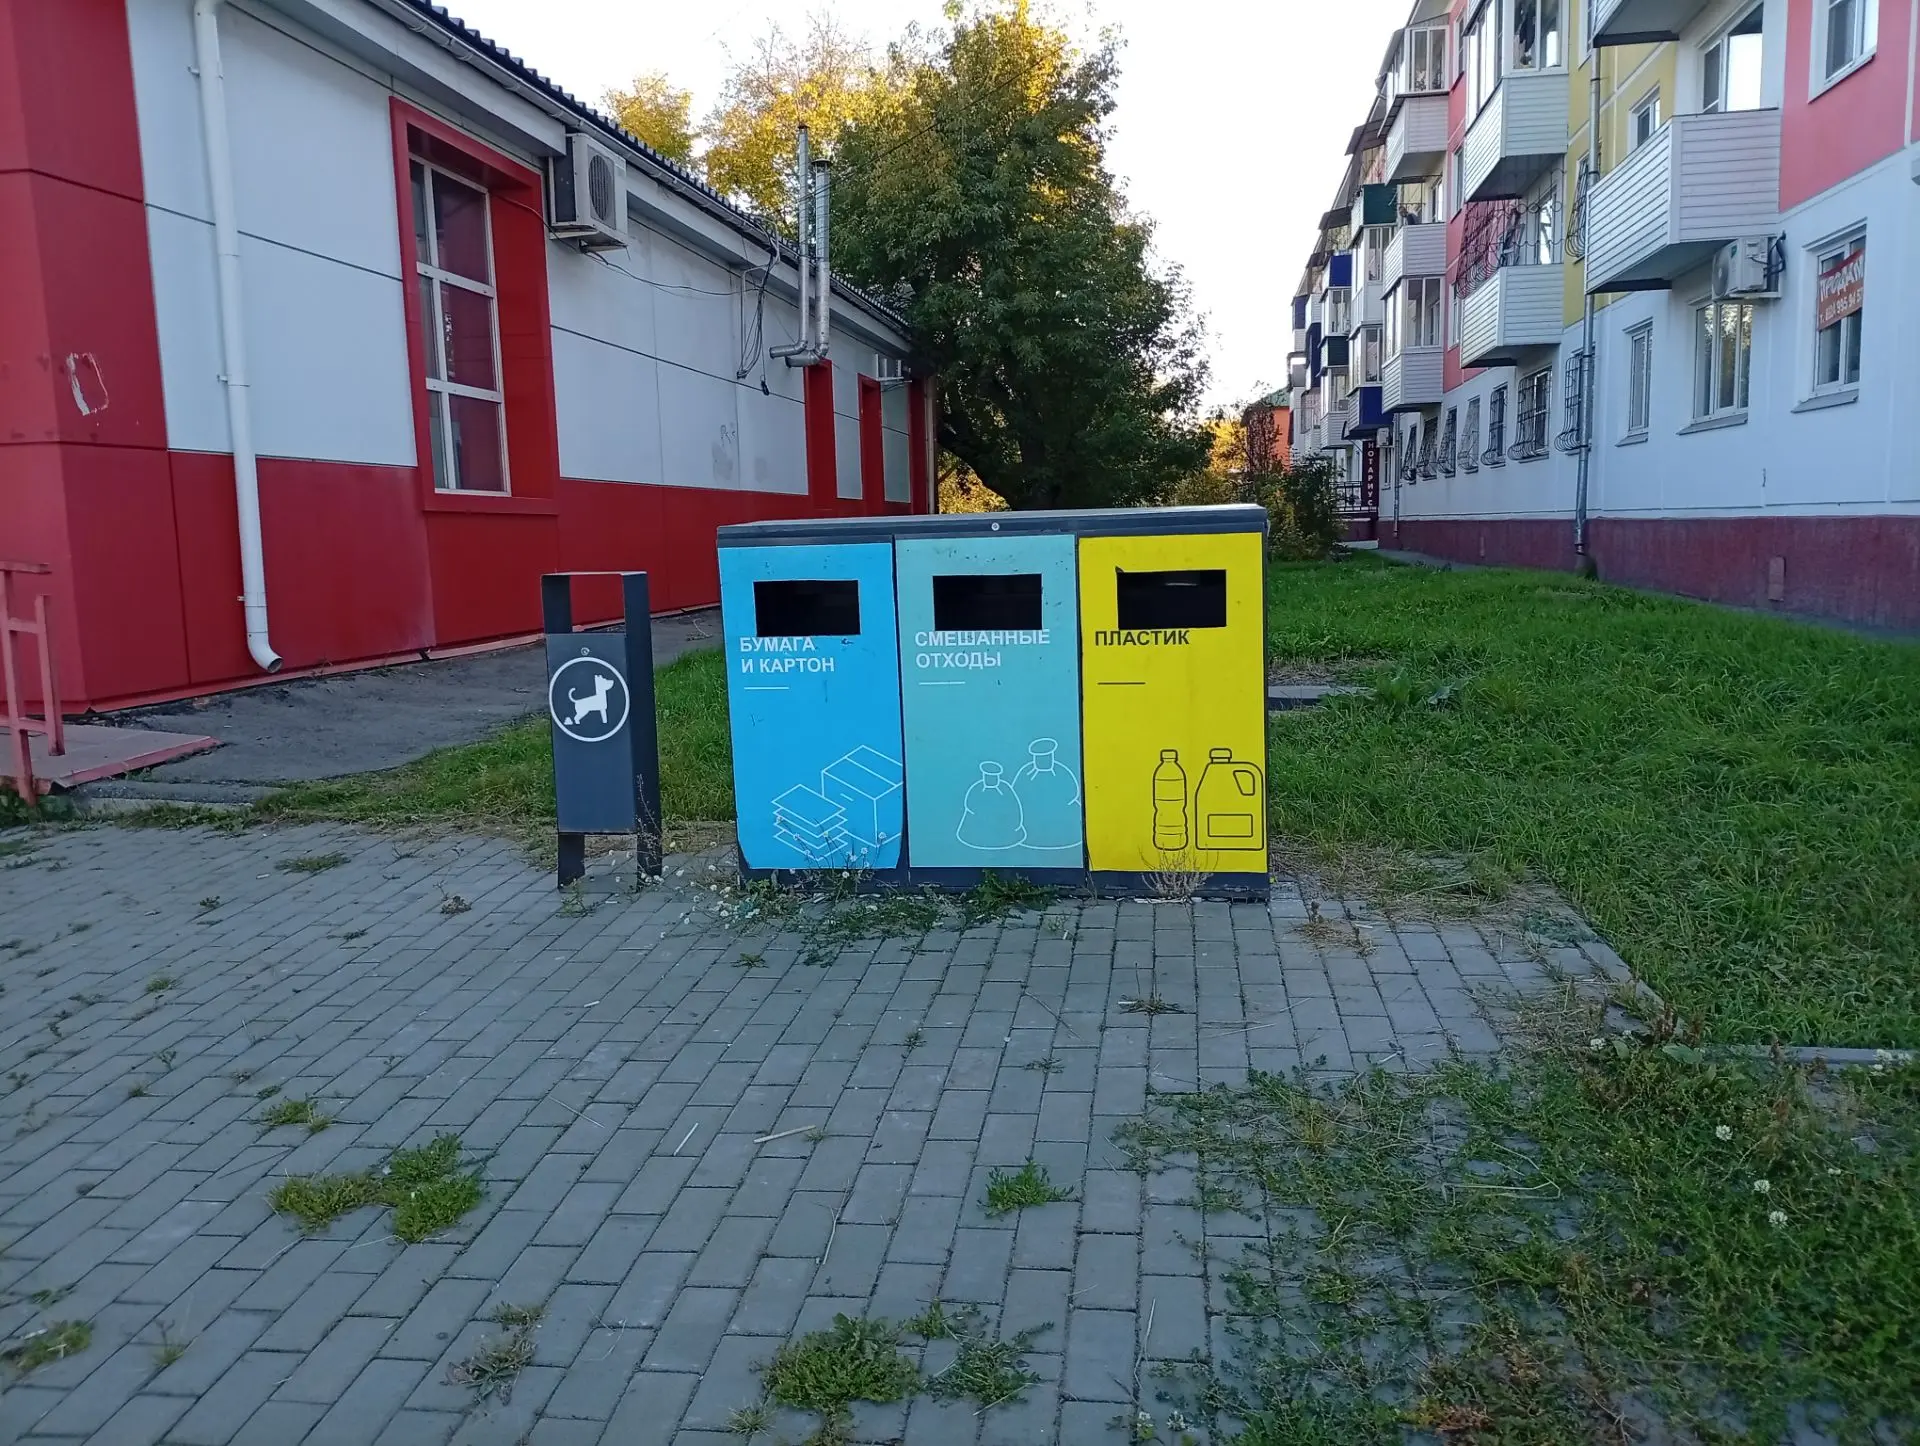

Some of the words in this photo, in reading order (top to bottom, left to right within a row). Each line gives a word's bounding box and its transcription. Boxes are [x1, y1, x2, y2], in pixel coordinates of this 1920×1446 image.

[1820, 254, 1865, 302] ПРОДАМ
[1367, 442, 1375, 506] НОТАРИУС
[739, 636, 816, 652] БУМАГА
[914, 628, 1051, 647] СМЕШАННЫЕ
[1095, 630, 1190, 646] ПЛАСТИК
[741, 658, 754, 673] И
[759, 657, 835, 673] КАРТОН
[915, 651, 1001, 670] ОТХОДЫ
